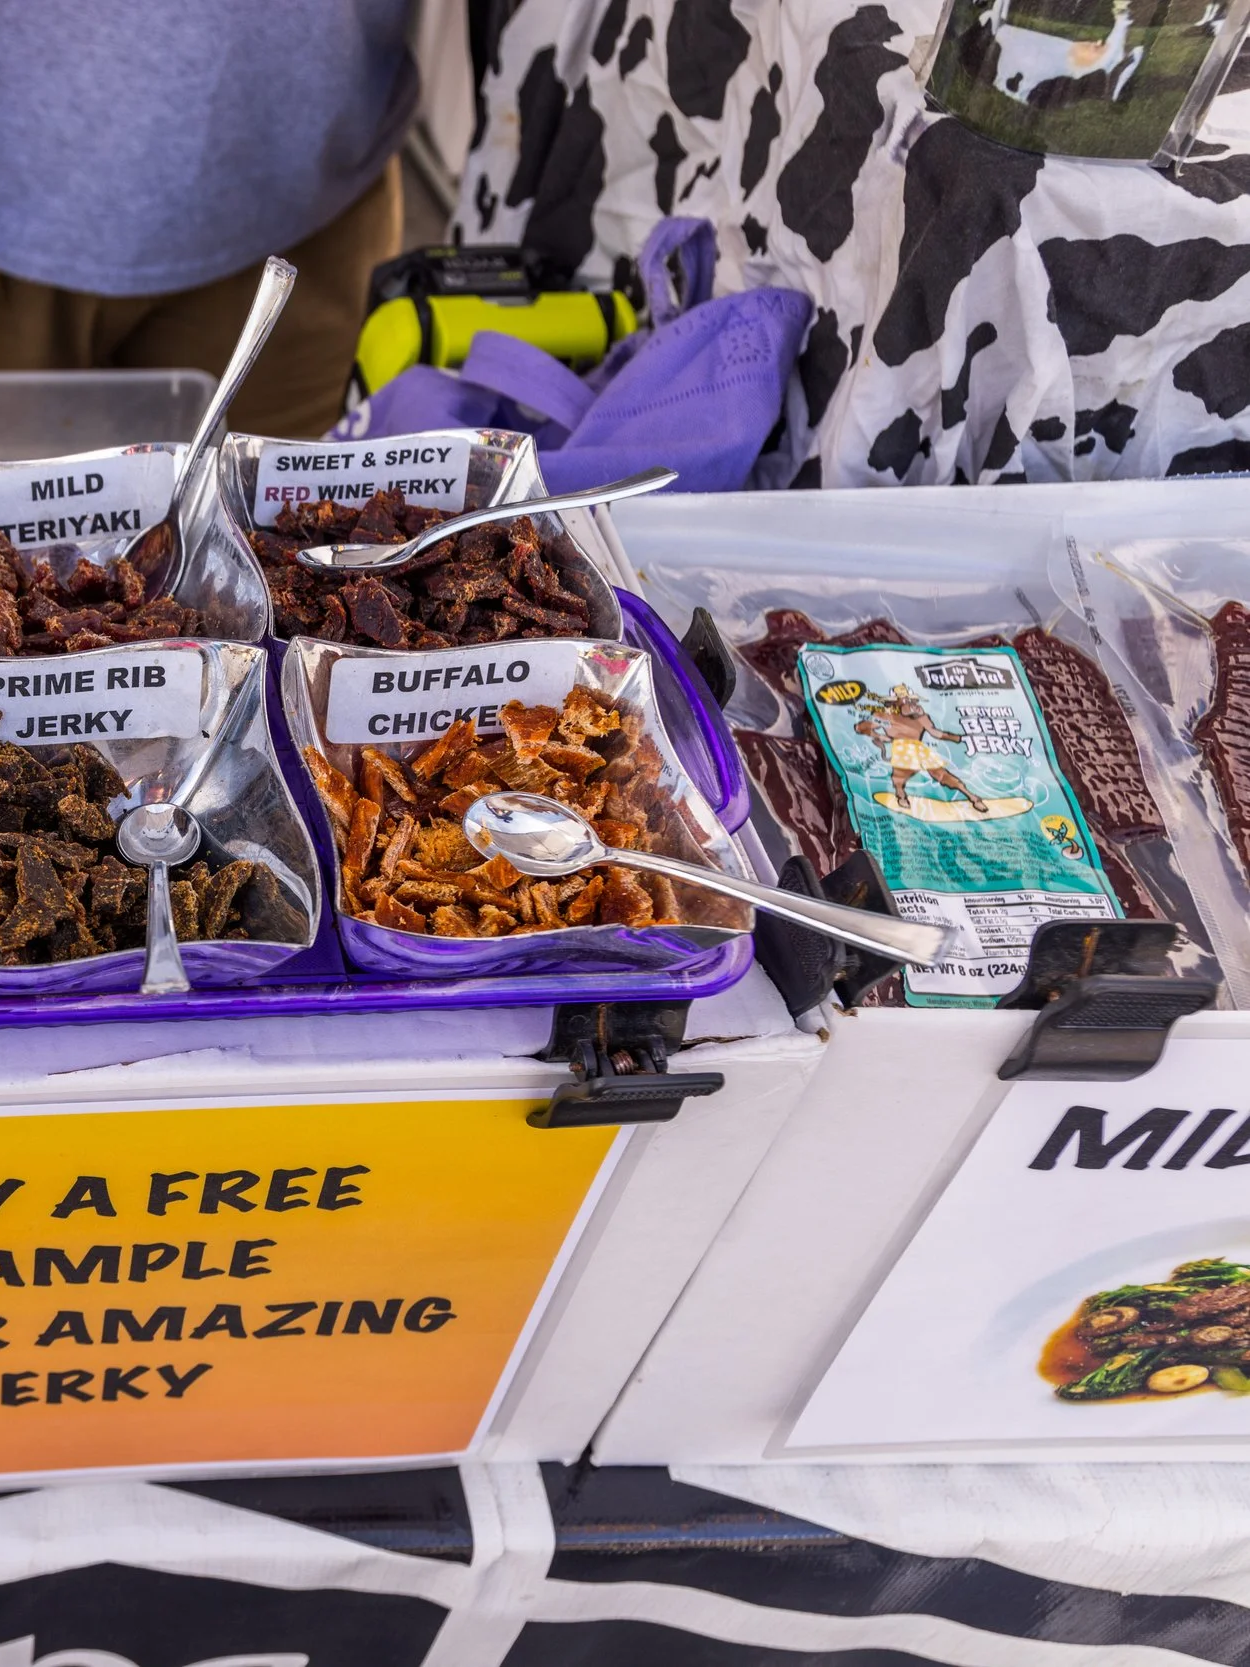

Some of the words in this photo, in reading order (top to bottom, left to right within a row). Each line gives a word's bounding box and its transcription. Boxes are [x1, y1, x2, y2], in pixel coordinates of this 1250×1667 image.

[276, 453, 355, 471] SWEET
[361, 451, 377, 467] &
[384, 447, 452, 466] SPICY
[31, 473, 104, 502] MILD
[264, 486, 311, 502] RED
[318, 482, 375, 500] WINE
[384, 478, 457, 496] JERKY
[107, 665, 167, 690] RIB
[372, 660, 530, 694] BUFFALO
[921, 667, 966, 687] Jerky
[969, 660, 1006, 685] Hut
[819, 682, 861, 704] MILD
[15, 709, 134, 738] JERKY
[368, 704, 507, 736] CHICKE
[956, 706, 1014, 718] TERIYAKI
[959, 718, 1021, 738] BEEF
[961, 734, 1033, 759] JERKY
[895, 892, 940, 906] utrition
[899, 904, 927, 914] acts
[938, 962, 956, 975] WT
[957, 964, 966, 977] 8
[968, 967, 985, 977] oz
[50, 1176, 118, 1219] A
[146, 1165, 370, 1216] FREE
[34, 1296, 457, 1348] AMAZING
